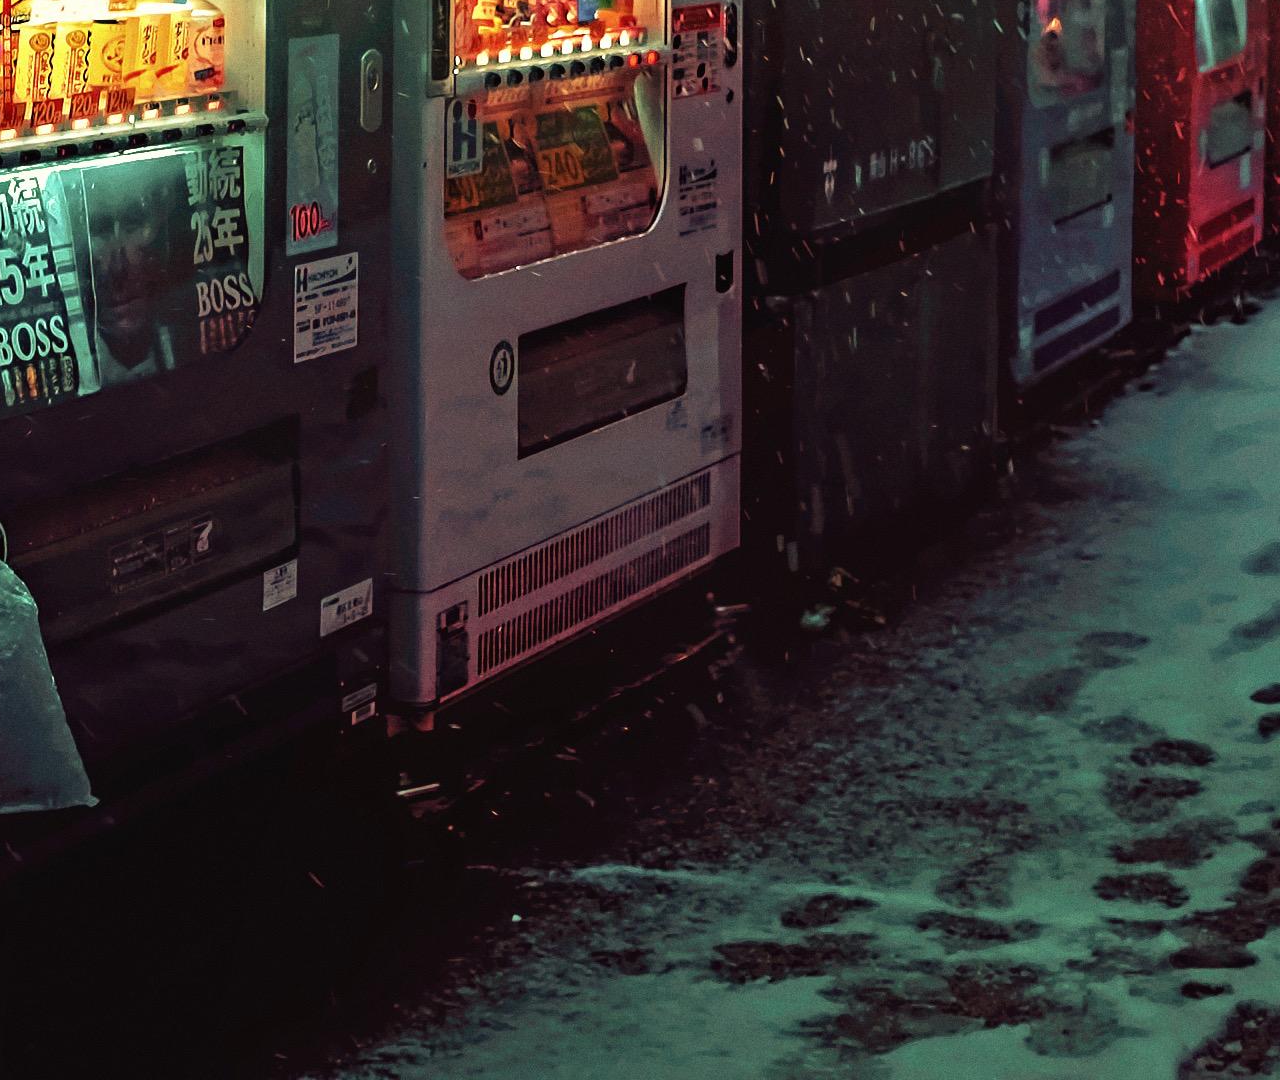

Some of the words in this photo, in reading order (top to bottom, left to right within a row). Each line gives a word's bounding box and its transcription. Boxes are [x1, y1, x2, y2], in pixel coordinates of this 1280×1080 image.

[184, 145, 244, 206] 勤続
[190, 206, 245, 266] 25年
[196, 271, 255, 318] BOSS
